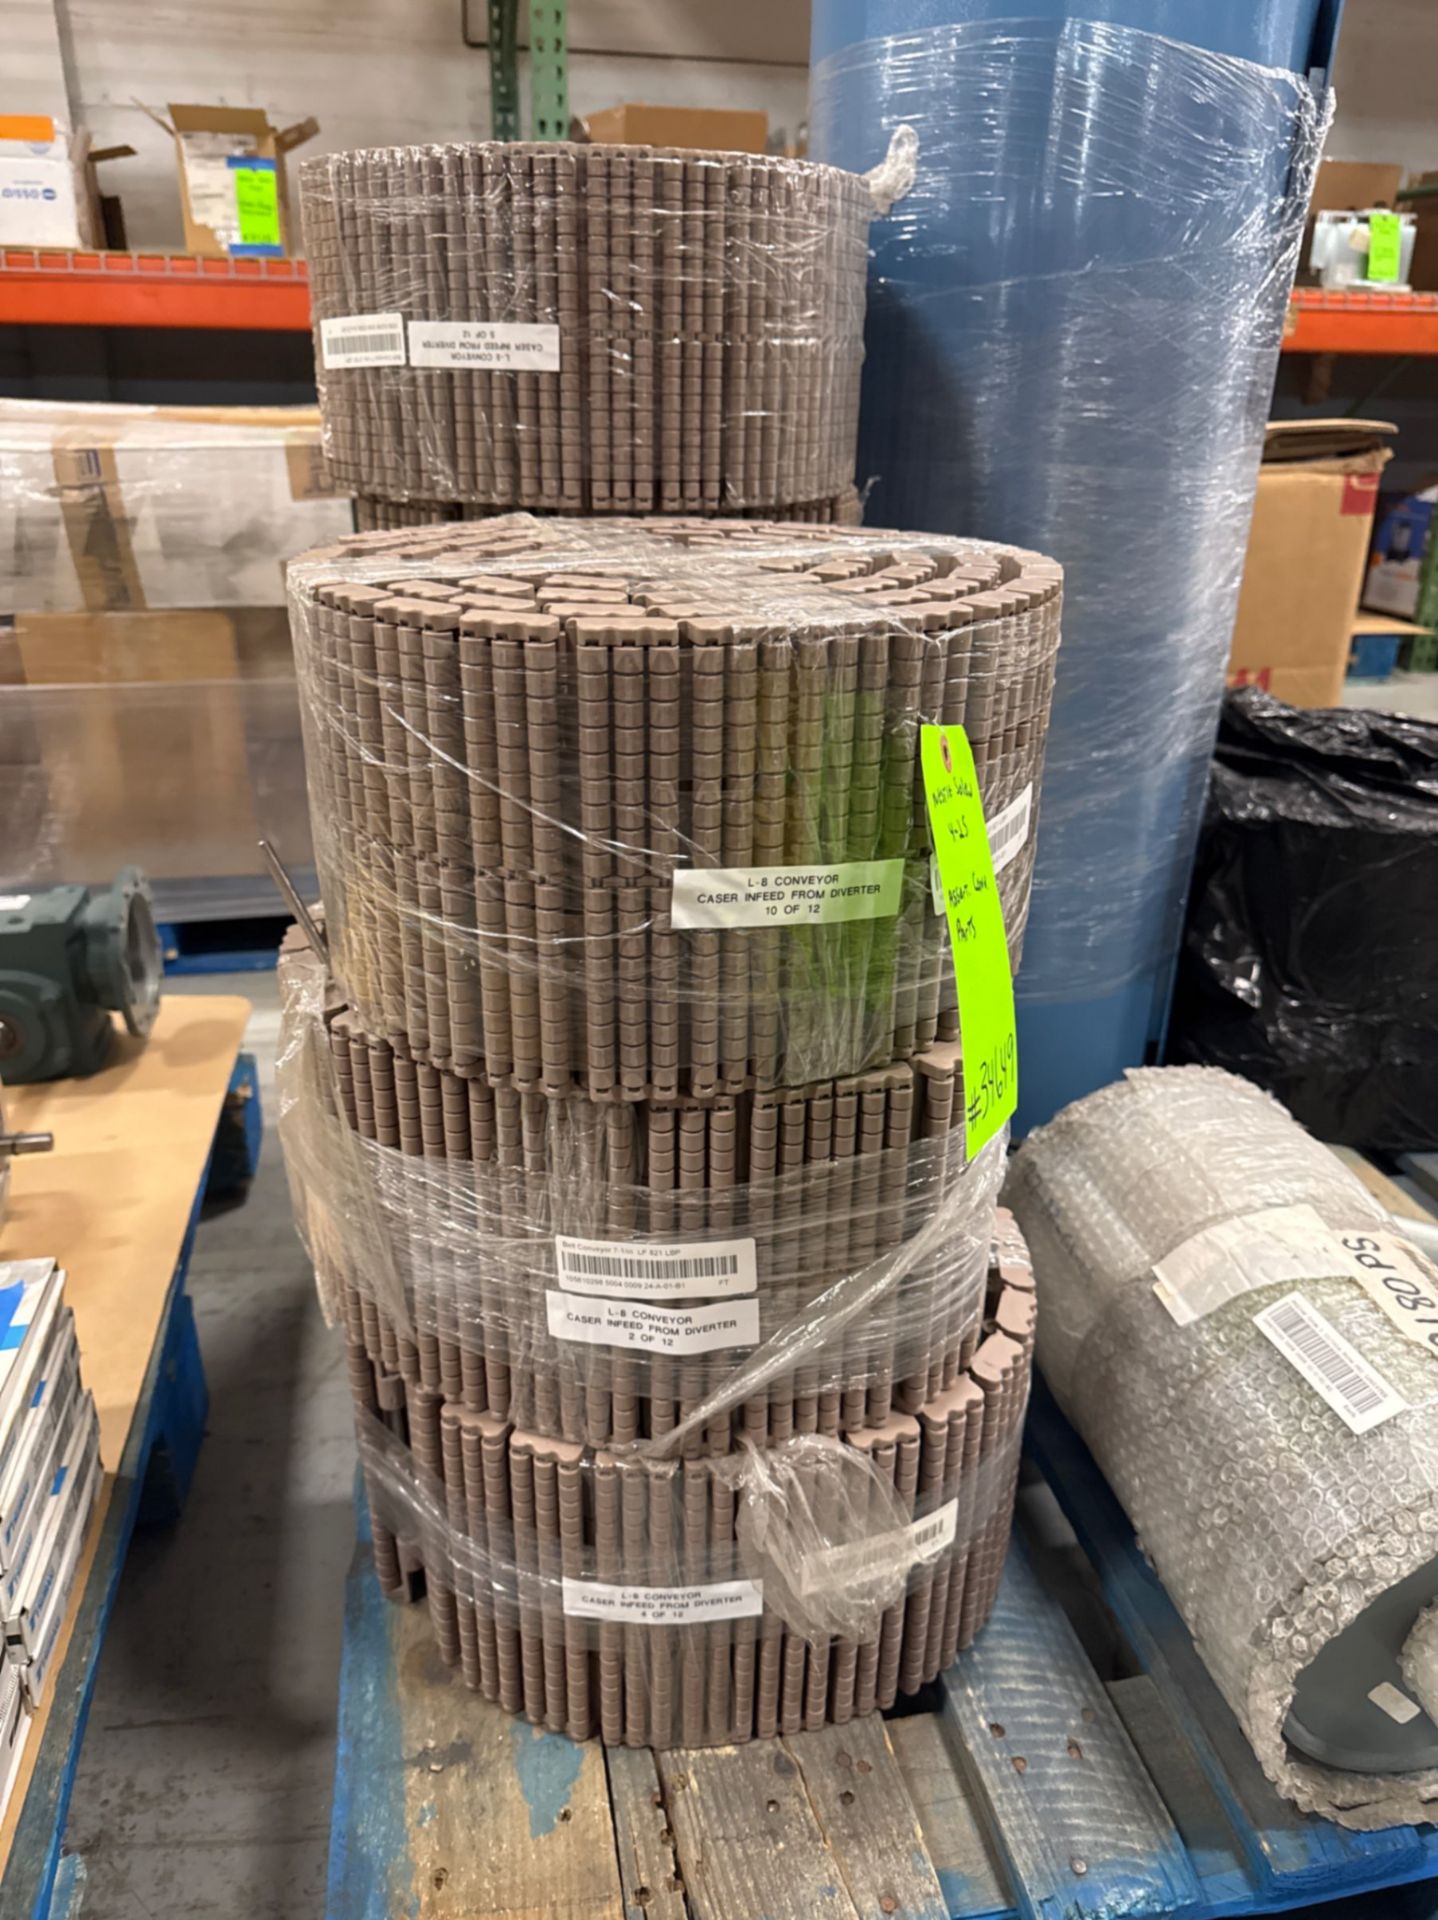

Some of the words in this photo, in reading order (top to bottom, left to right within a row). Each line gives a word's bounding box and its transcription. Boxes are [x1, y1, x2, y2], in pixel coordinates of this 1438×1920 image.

[462, 330, 472, 338] 12
[475, 330, 487, 339] OF
[422, 340, 457, 349] DIVERTER
[459, 341, 481, 350] FROM
[484, 342, 512, 351] INFEED
[514, 342, 543, 352] CASER
[451, 352, 493, 362] CONVEYOR
[747, 877, 768, 888] L-8
[774, 874, 840, 886] CONVEYOR
[697, 893, 739, 905] CASER
[745, 891, 785, 902] INFEED
[791, 889, 825, 900] FROM
[830, 884, 881, 898] DIVERTER
[765, 906, 778, 916] 10
[783, 905, 801, 914] OF
[808, 904, 821, 914] 12
[577, 1243, 611, 1255] Conveyor
[718, 1279, 729, 1287] FT
[608, 1307, 627, 1318] L-8
[632, 1310, 693, 1326] CONVEYOR
[566, 1312, 602, 1326] CASER
[607, 1319, 643, 1331] INFEED
[648, 1325, 680, 1336] FROM
[685, 1319, 737, 1336] DIVERTER
[628, 1332, 635, 1341] 2
[640, 1333, 655, 1343] OF
[662, 1337, 674, 1347] 12
[644, 1591, 702, 1600] CONVEYOR
[581, 1595, 615, 1607] CASER
[620, 1601, 655, 1609] INFEED
[659, 1601, 690, 1610] FROM
[694, 1595, 743, 1608] DIVERTER
